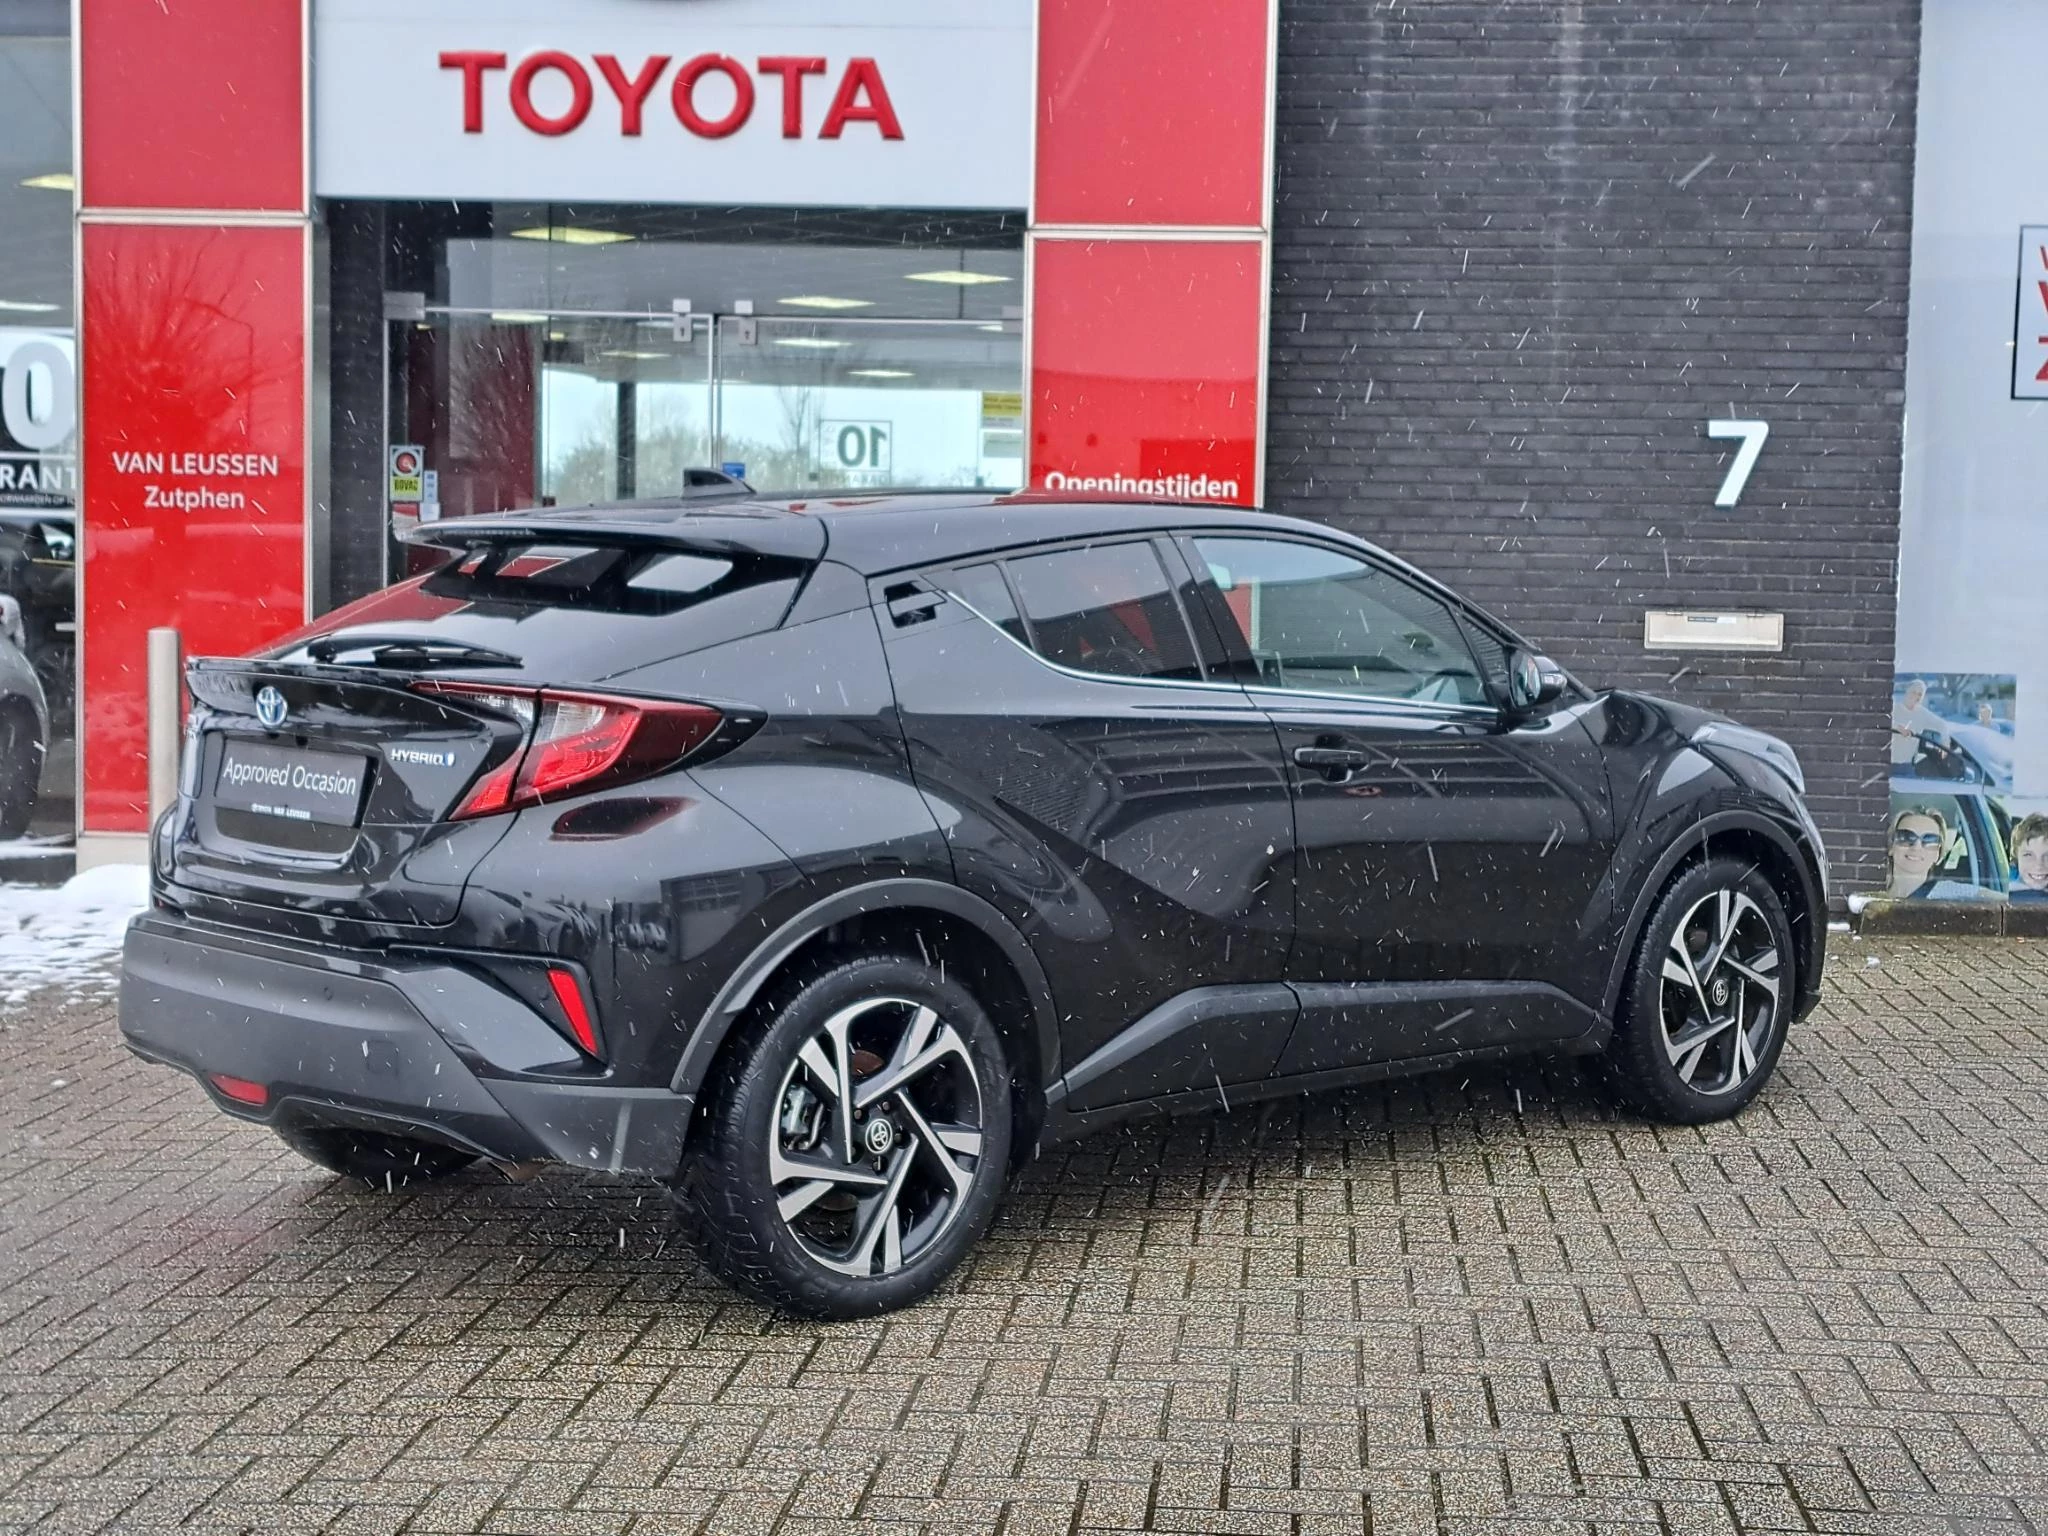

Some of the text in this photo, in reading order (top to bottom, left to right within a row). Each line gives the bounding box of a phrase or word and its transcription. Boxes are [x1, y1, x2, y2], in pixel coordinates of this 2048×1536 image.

[438, 49, 904, 140] TOYOTA
[112, 451, 279, 476] VAN LEUSSEN
[1708, 420, 1769, 506] 7
[144, 485, 245, 513] Zutphen
[391, 748, 446, 766] HYBRID
[223, 757, 356, 796] Approved Occasion
